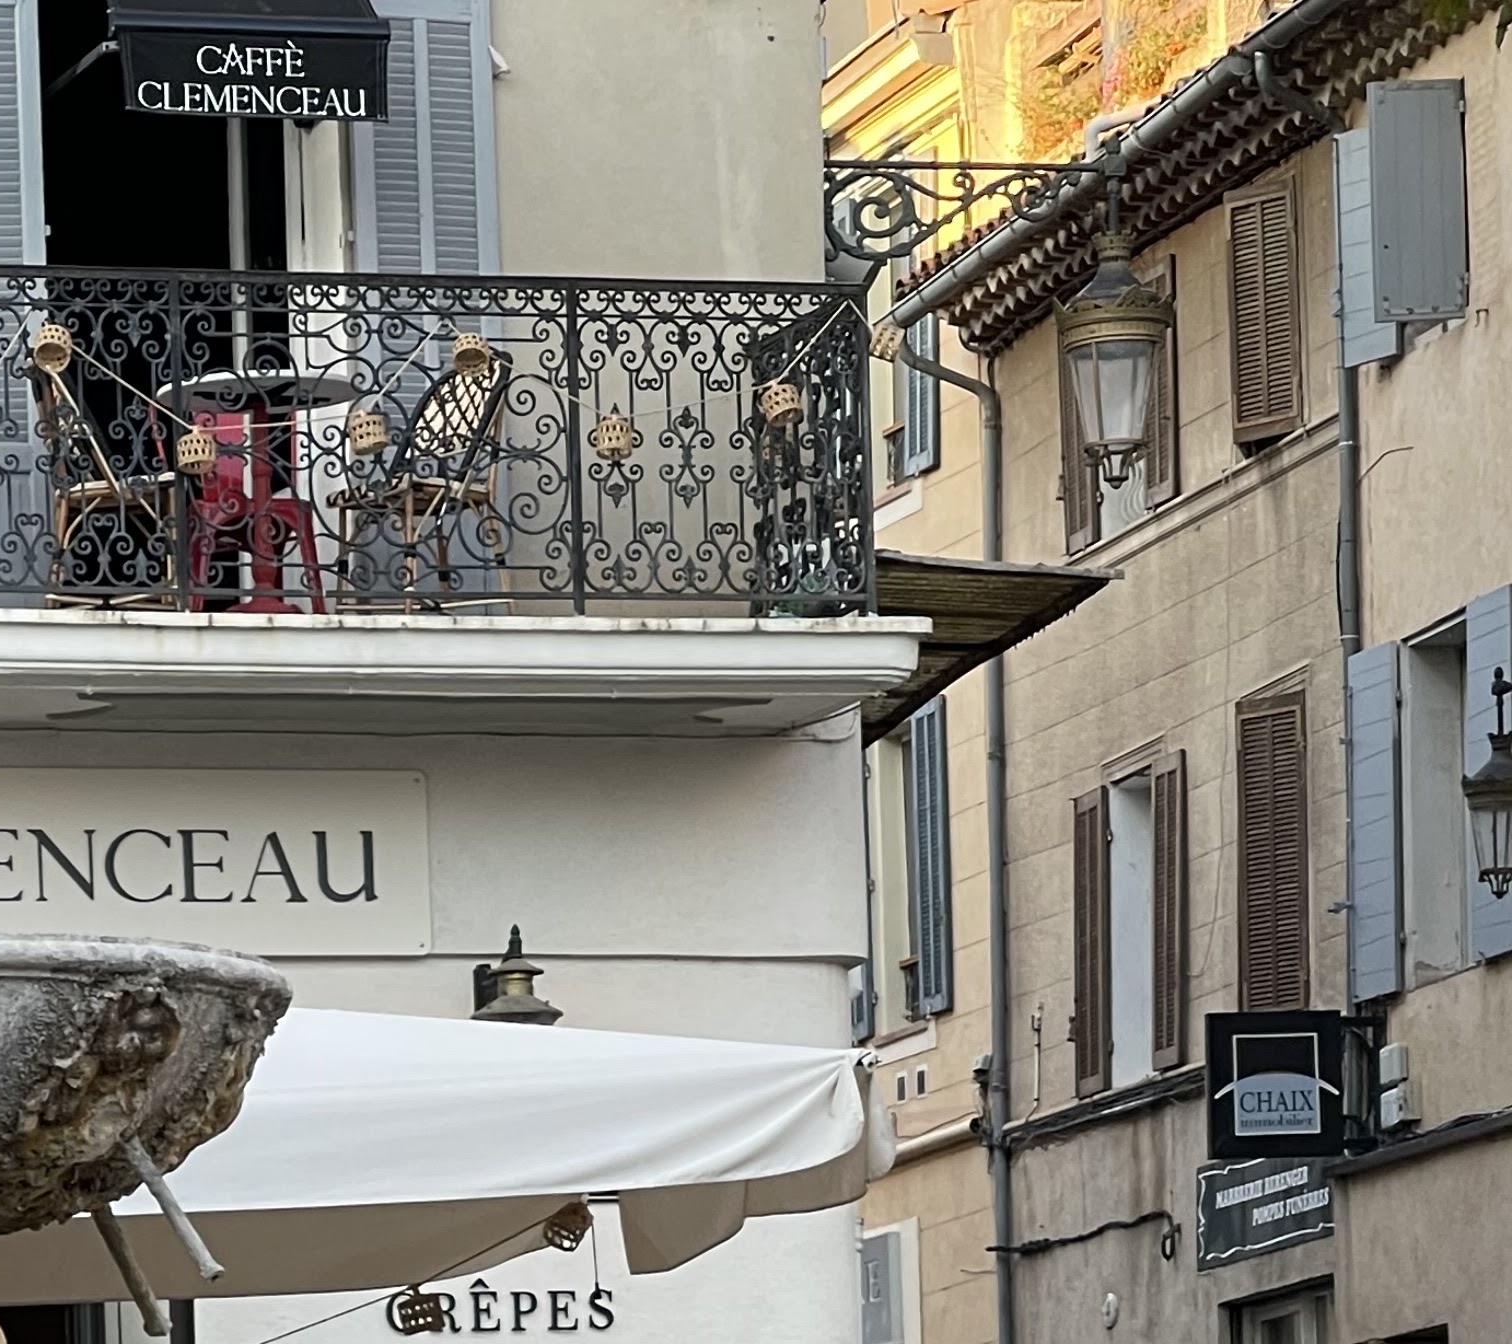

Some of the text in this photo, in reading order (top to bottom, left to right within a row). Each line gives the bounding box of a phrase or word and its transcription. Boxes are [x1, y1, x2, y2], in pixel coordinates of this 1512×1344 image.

[195, 40, 306, 78] CAFFÈ
[137, 80, 367, 117] CLEMENCEAU
[1239, 1089, 1314, 1114] CHAIX
